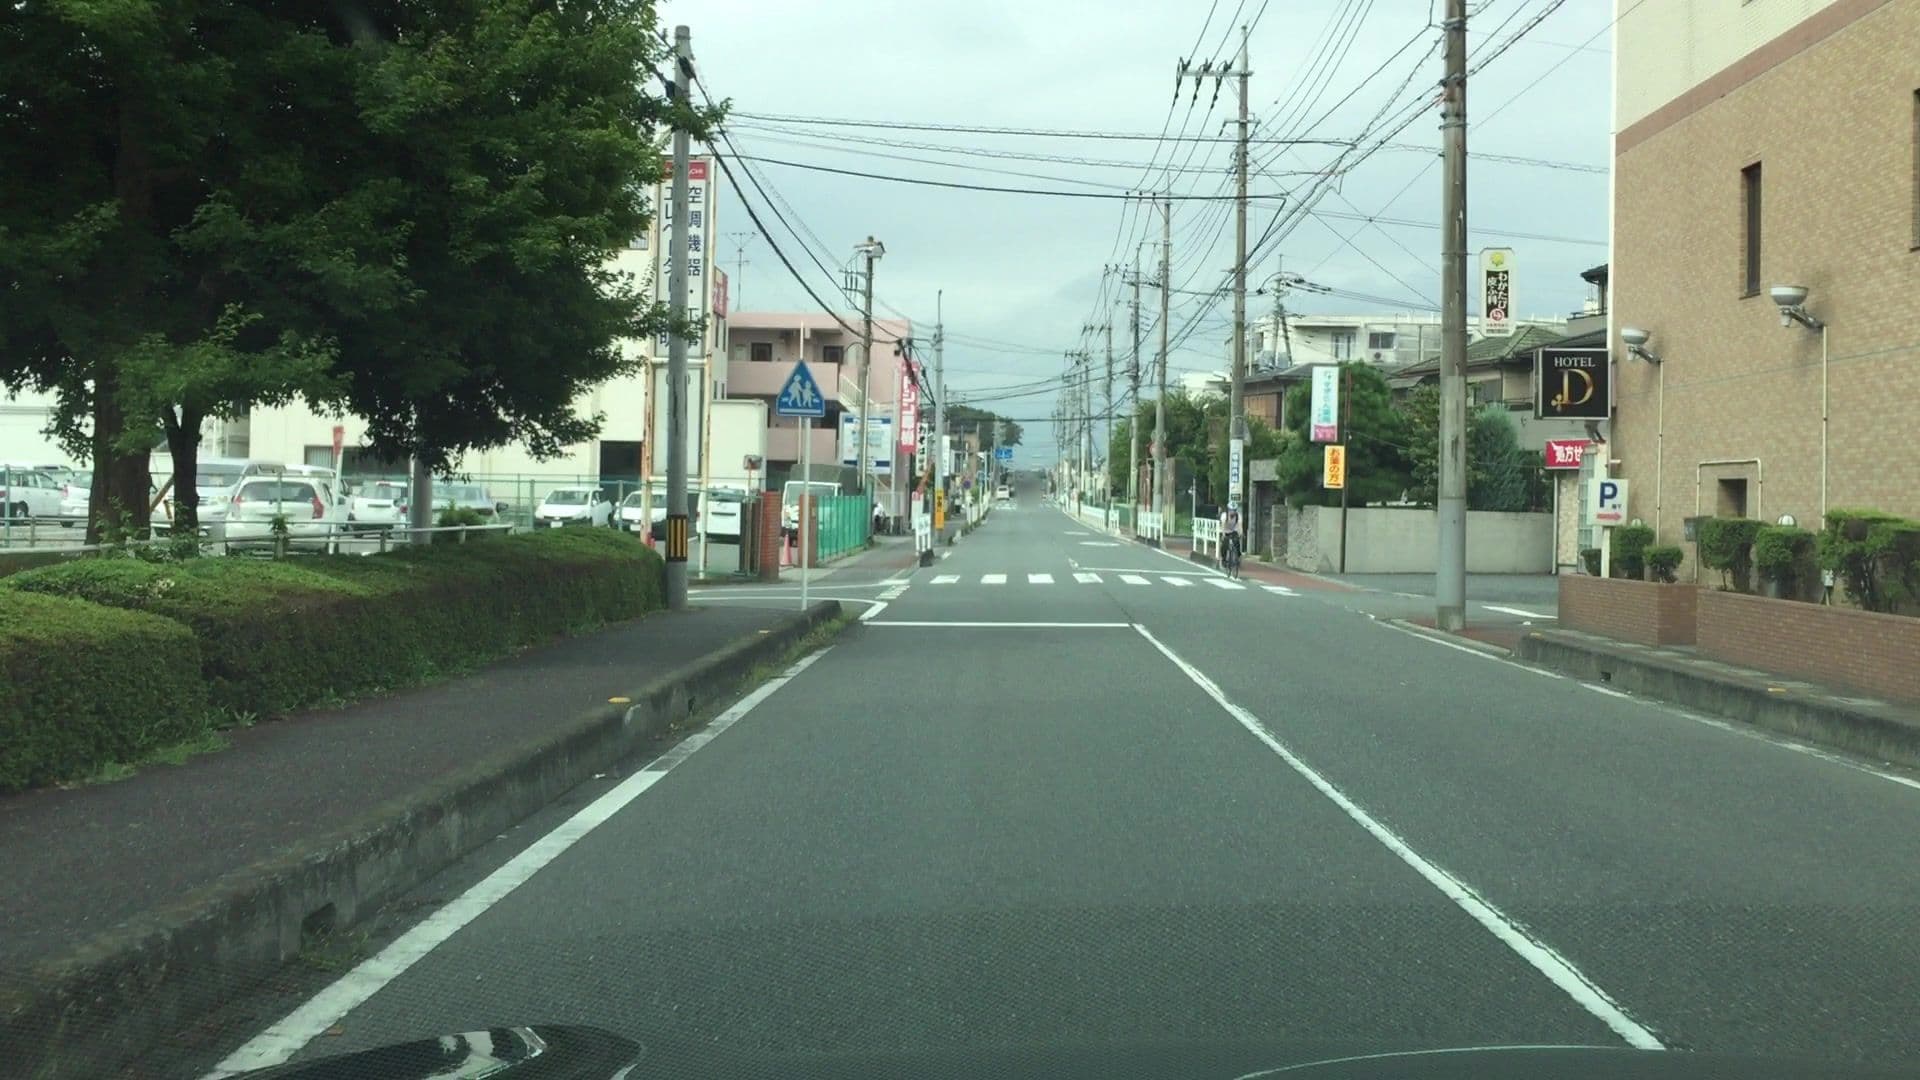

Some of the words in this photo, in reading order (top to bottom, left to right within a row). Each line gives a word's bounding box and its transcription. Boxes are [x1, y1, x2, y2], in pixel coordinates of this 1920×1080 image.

[1553, 356, 1596, 368] HOTEL
[1557, 368, 1594, 405] D
[1598, 482, 1617, 508] P
